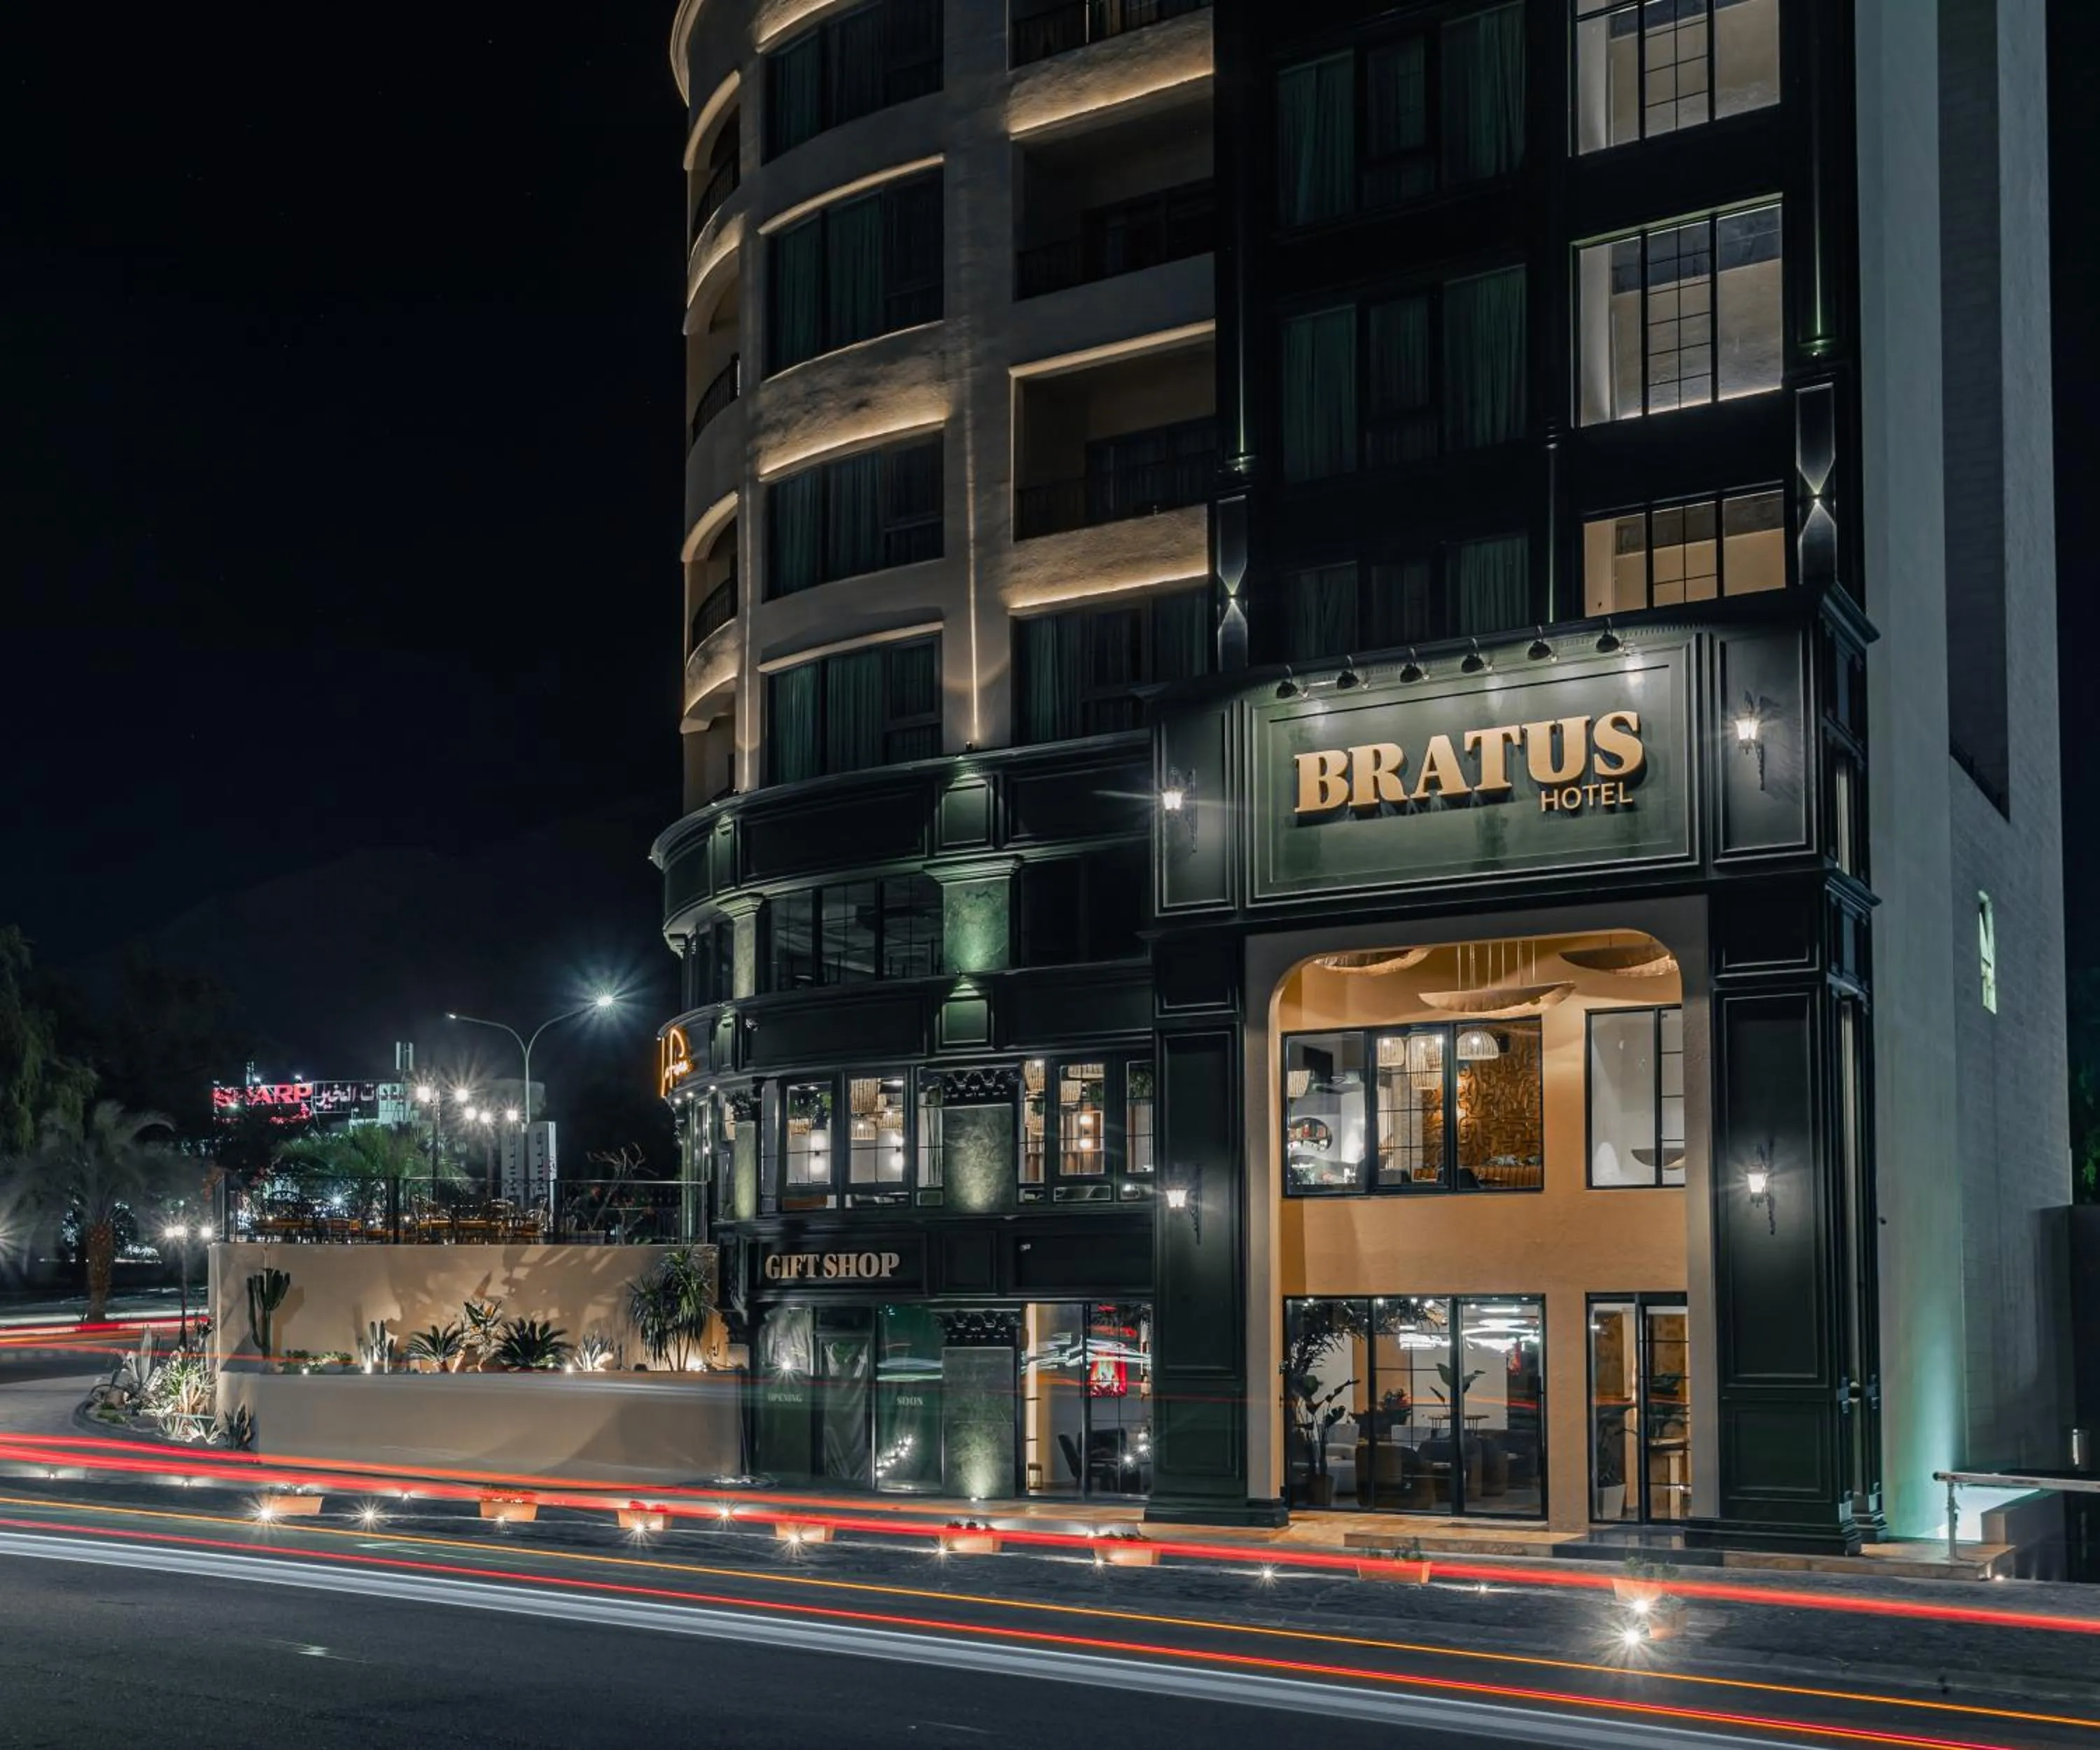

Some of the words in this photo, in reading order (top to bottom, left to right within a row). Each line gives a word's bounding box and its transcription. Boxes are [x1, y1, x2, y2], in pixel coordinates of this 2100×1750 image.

[1294, 710, 1645, 813] BRATUS
[1539, 782, 1634, 813] HOTEL
[765, 1254, 820, 1280] GIFT
[822, 1252, 901, 1279] SHOP
